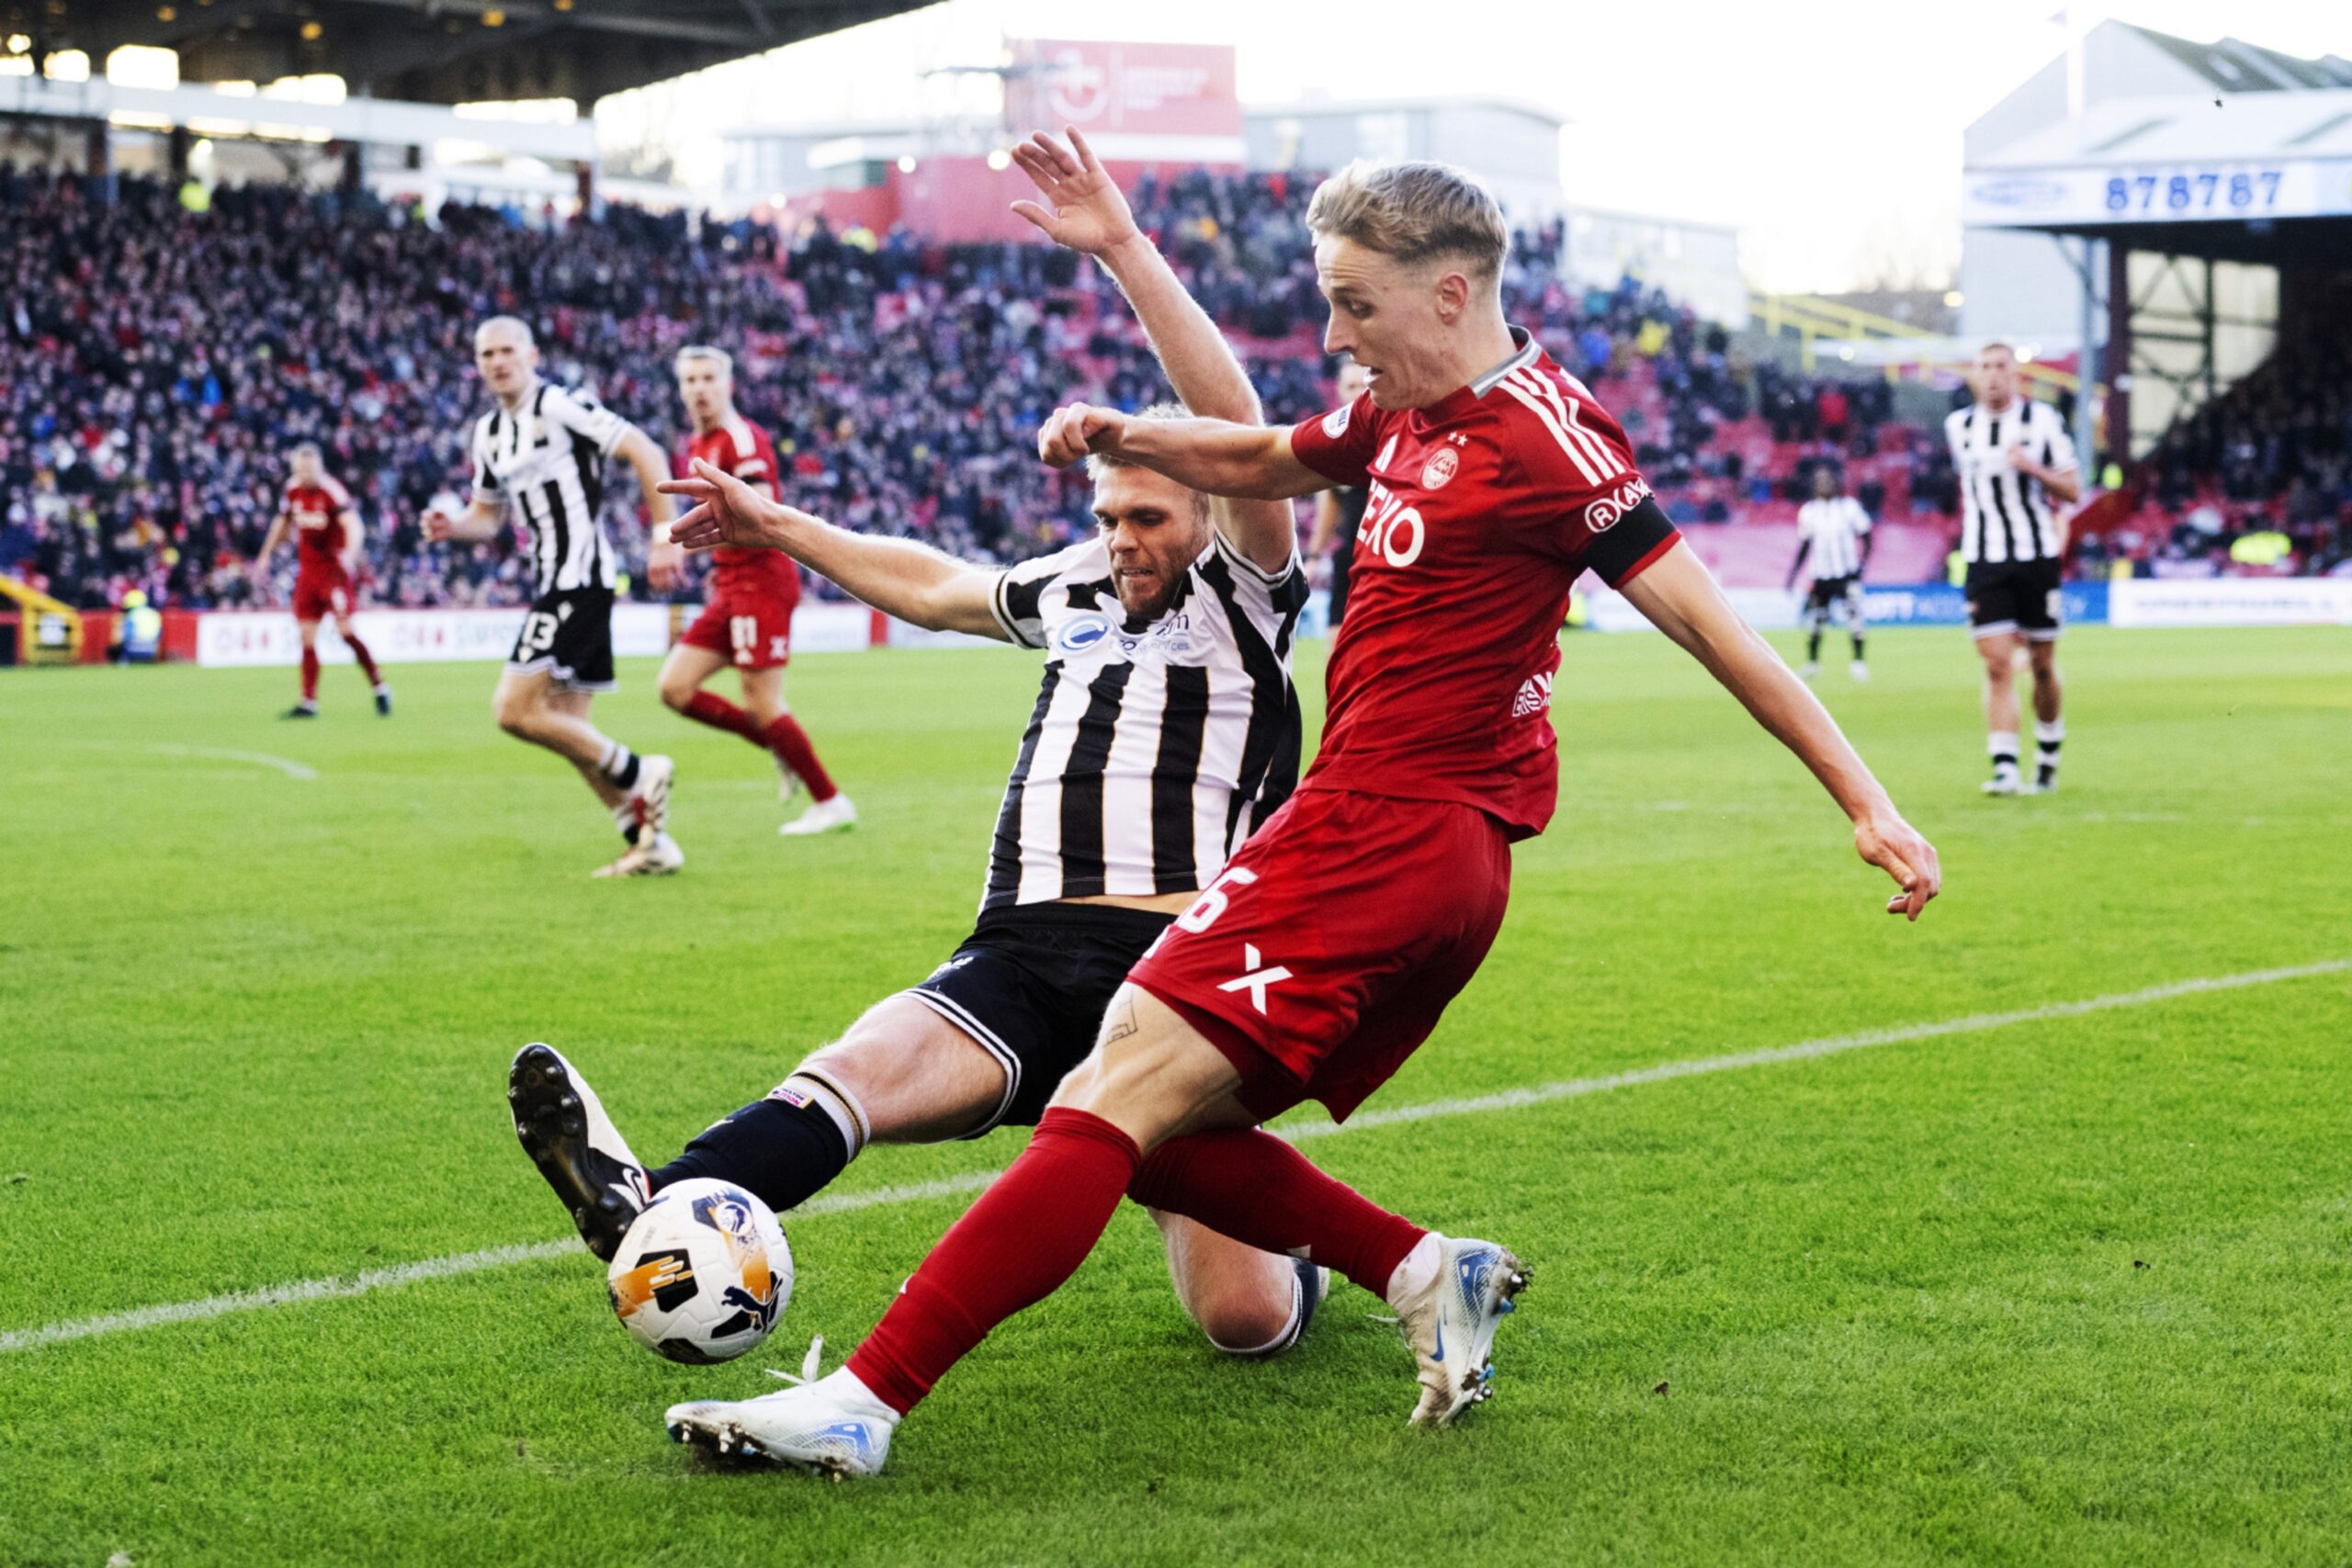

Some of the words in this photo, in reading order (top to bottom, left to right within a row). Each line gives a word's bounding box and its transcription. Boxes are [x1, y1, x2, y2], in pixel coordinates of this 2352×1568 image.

[2106, 171, 2282, 210] 878787
[1356, 477, 1424, 567] EXO
[522, 612, 559, 650] 13
[1175, 866, 1260, 934] 6
